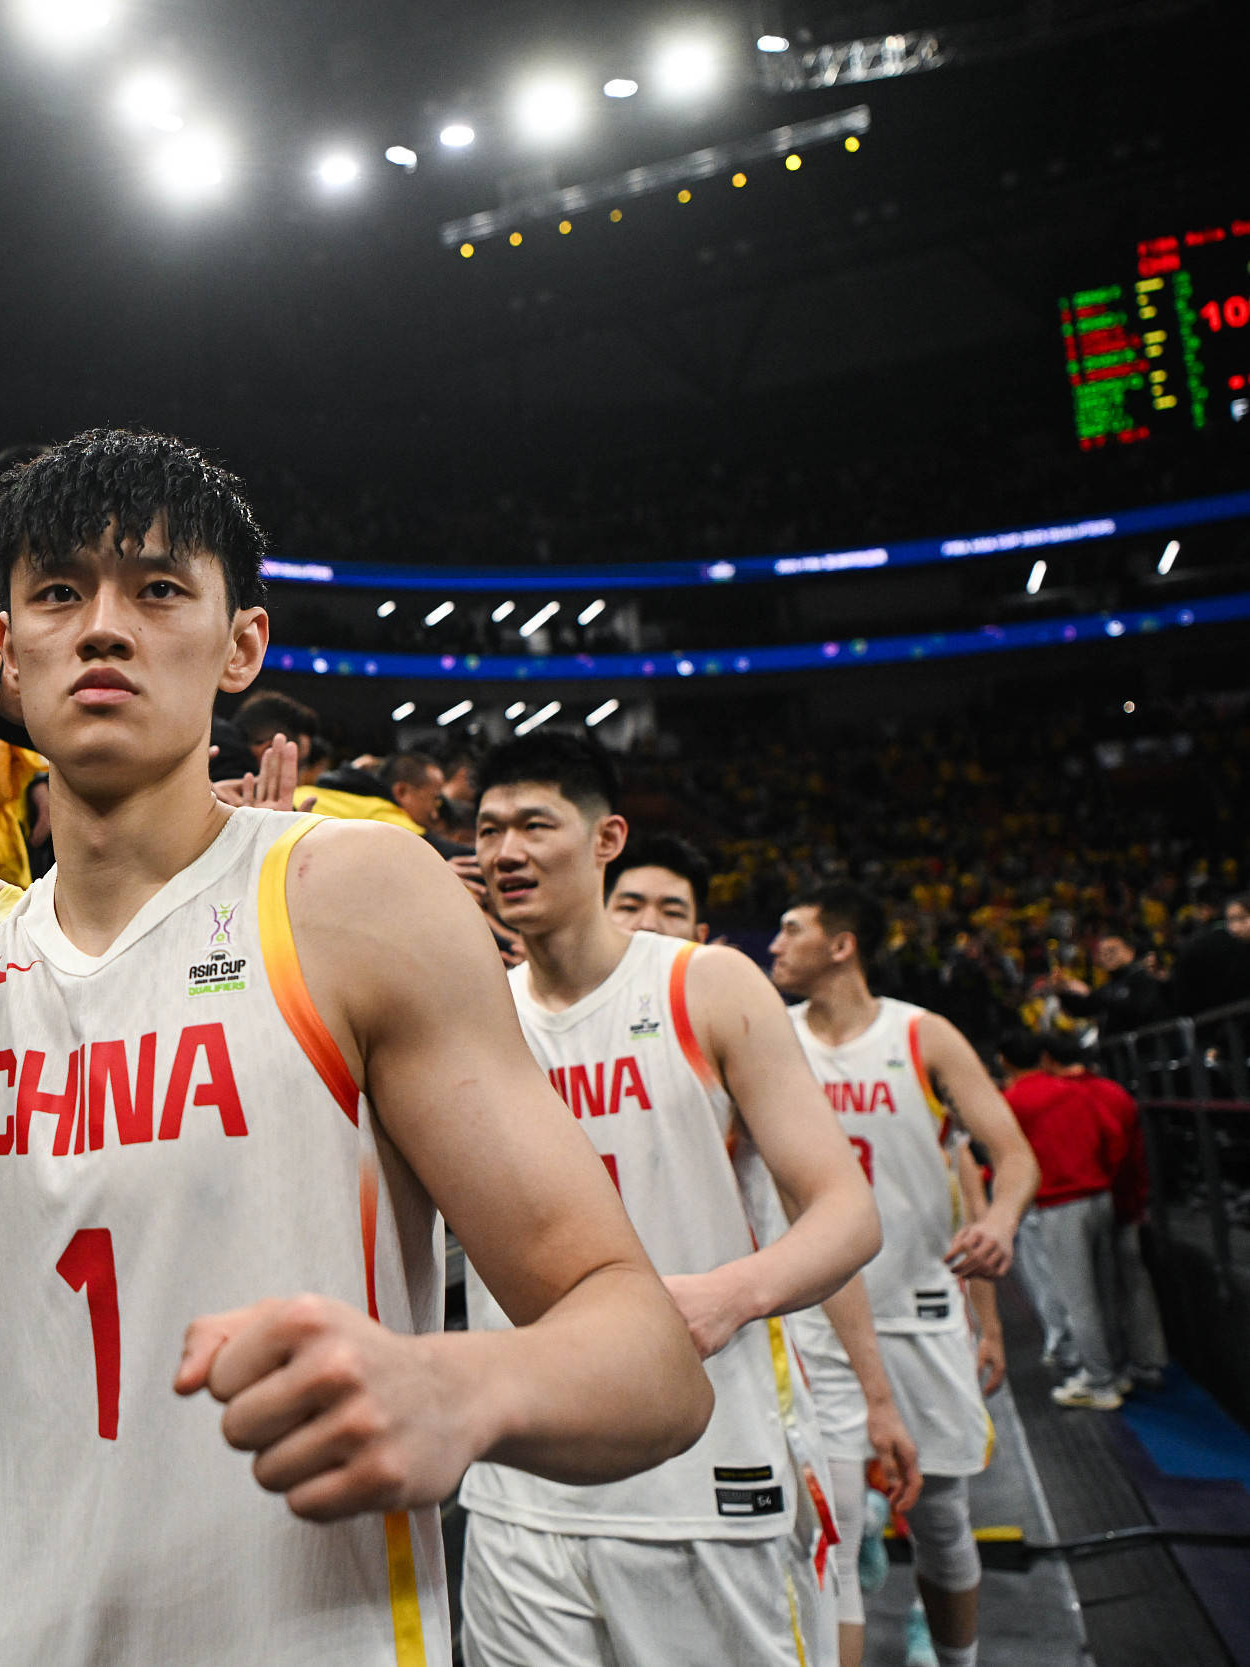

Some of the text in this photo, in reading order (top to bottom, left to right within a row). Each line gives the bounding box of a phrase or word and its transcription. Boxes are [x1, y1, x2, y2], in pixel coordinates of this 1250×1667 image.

[1200, 296, 1250, 332] 10
[189, 963, 217, 980] ASIA
[220, 959, 246, 975] CUP
[548, 1056, 652, 1119] INA
[823, 1081, 896, 1114] INA
[56, 1228, 120, 1441] 1
